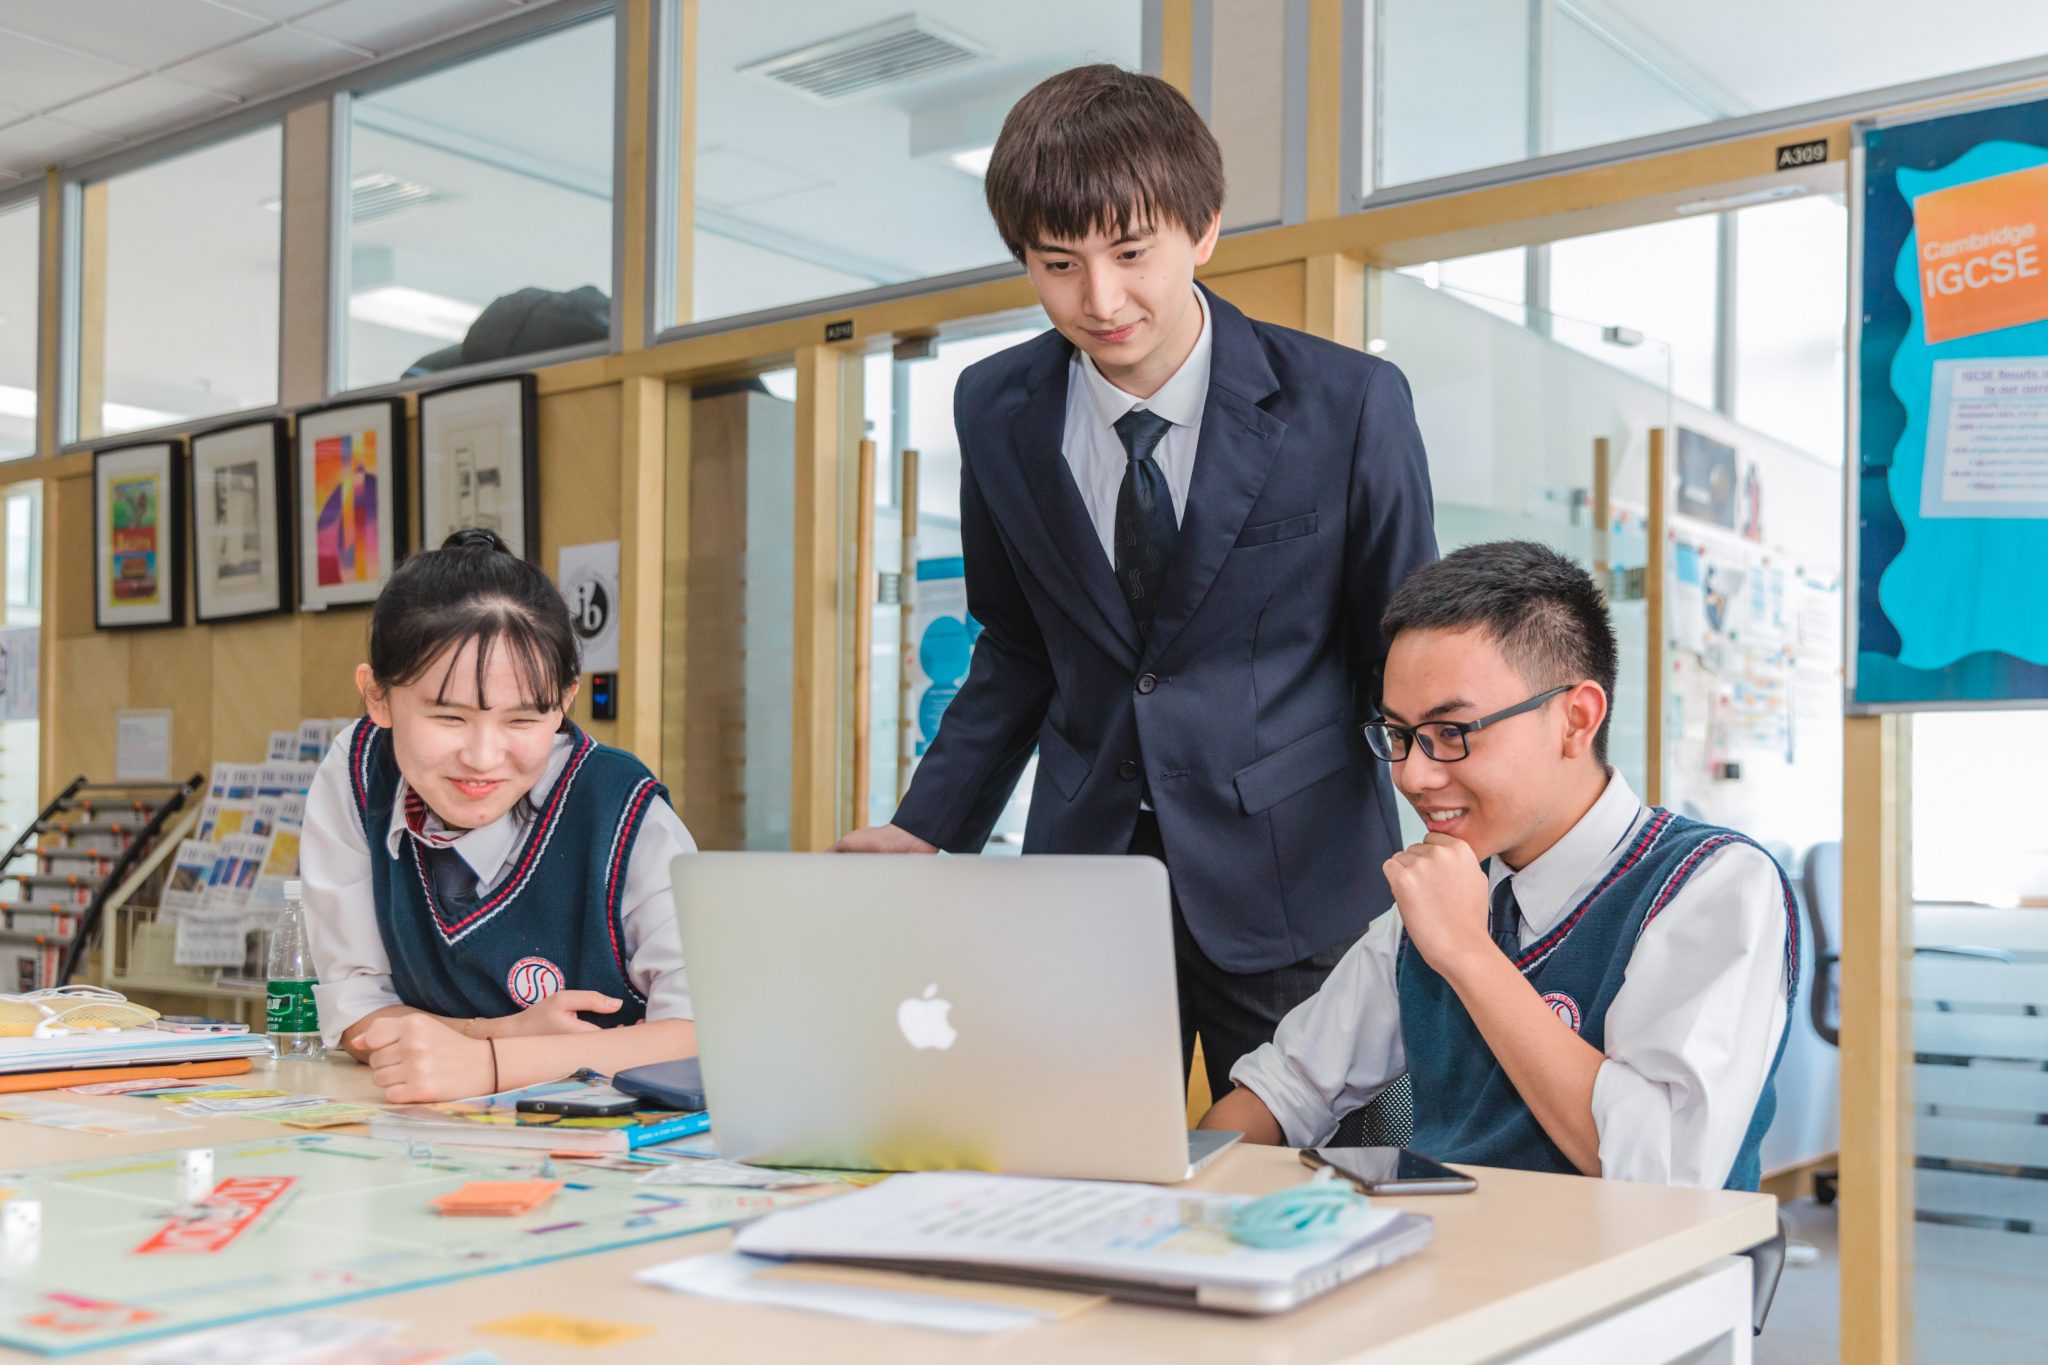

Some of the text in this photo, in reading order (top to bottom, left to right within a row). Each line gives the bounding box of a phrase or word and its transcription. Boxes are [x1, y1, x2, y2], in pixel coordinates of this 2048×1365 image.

[1780, 143, 1826, 167] A309
[1923, 223, 2036, 262] Cambridge
[1926, 244, 2041, 298] IGCSE
